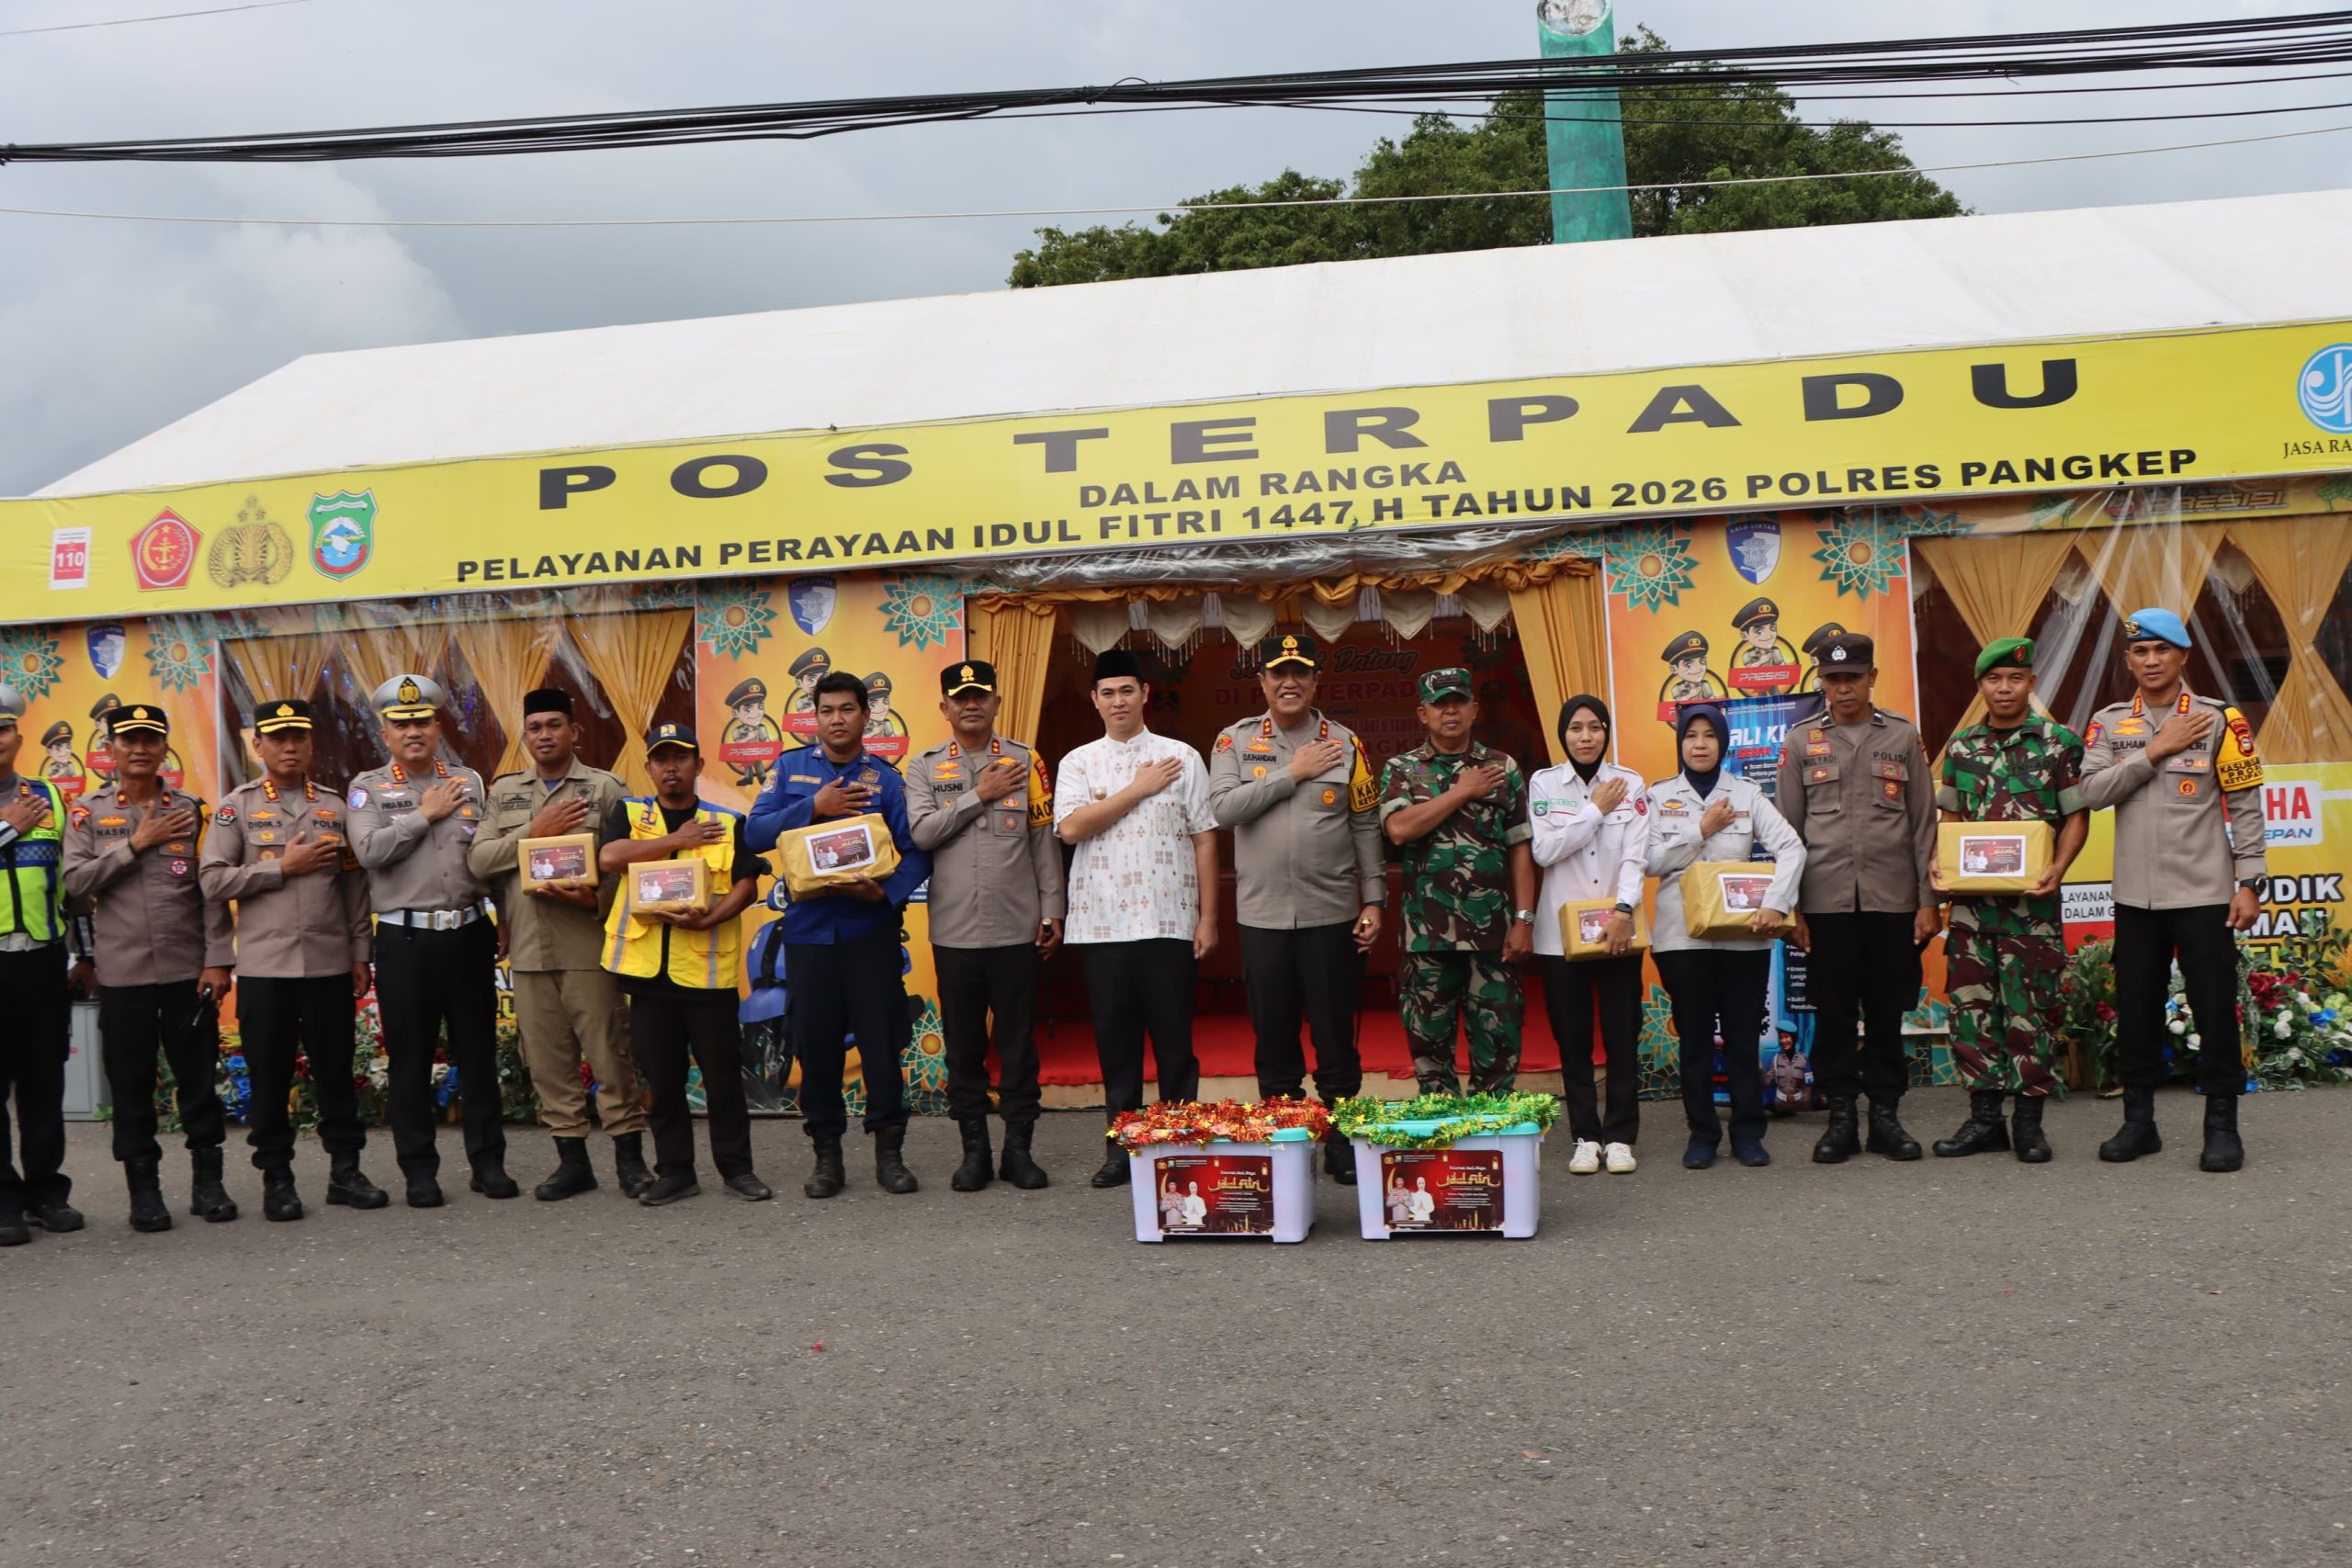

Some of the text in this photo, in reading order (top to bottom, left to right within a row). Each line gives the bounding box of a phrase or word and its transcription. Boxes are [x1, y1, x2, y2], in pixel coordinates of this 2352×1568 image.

[538, 357, 2078, 511] POS TERPADU
[2282, 441, 2324, 459] JASA
[1080, 461, 1466, 508] DALAM RANGKA
[457, 448, 2197, 583] PELAYANAN PERAYAAN IDUL FITRI 1447 H TAHUN 2026 POLRES PANGKEP
[56, 551, 85, 568] 110
[1333, 646, 1419, 675] Datang
[1739, 671, 1790, 682] PRESISI
[1316, 679, 1417, 701] TERPAD
[2111, 739, 2146, 751] ZULHAM
[2190, 742, 2207, 751] LRI
[729, 747, 774, 756] PRESISI
[1873, 750, 1907, 762] POLISI
[933, 783, 964, 794] HUSNI
[312, 819, 342, 829] POLRI
[96, 828, 130, 837] NASRI
[2264, 828, 2313, 840] EPAN
[2064, 907, 2105, 919] DALAM
